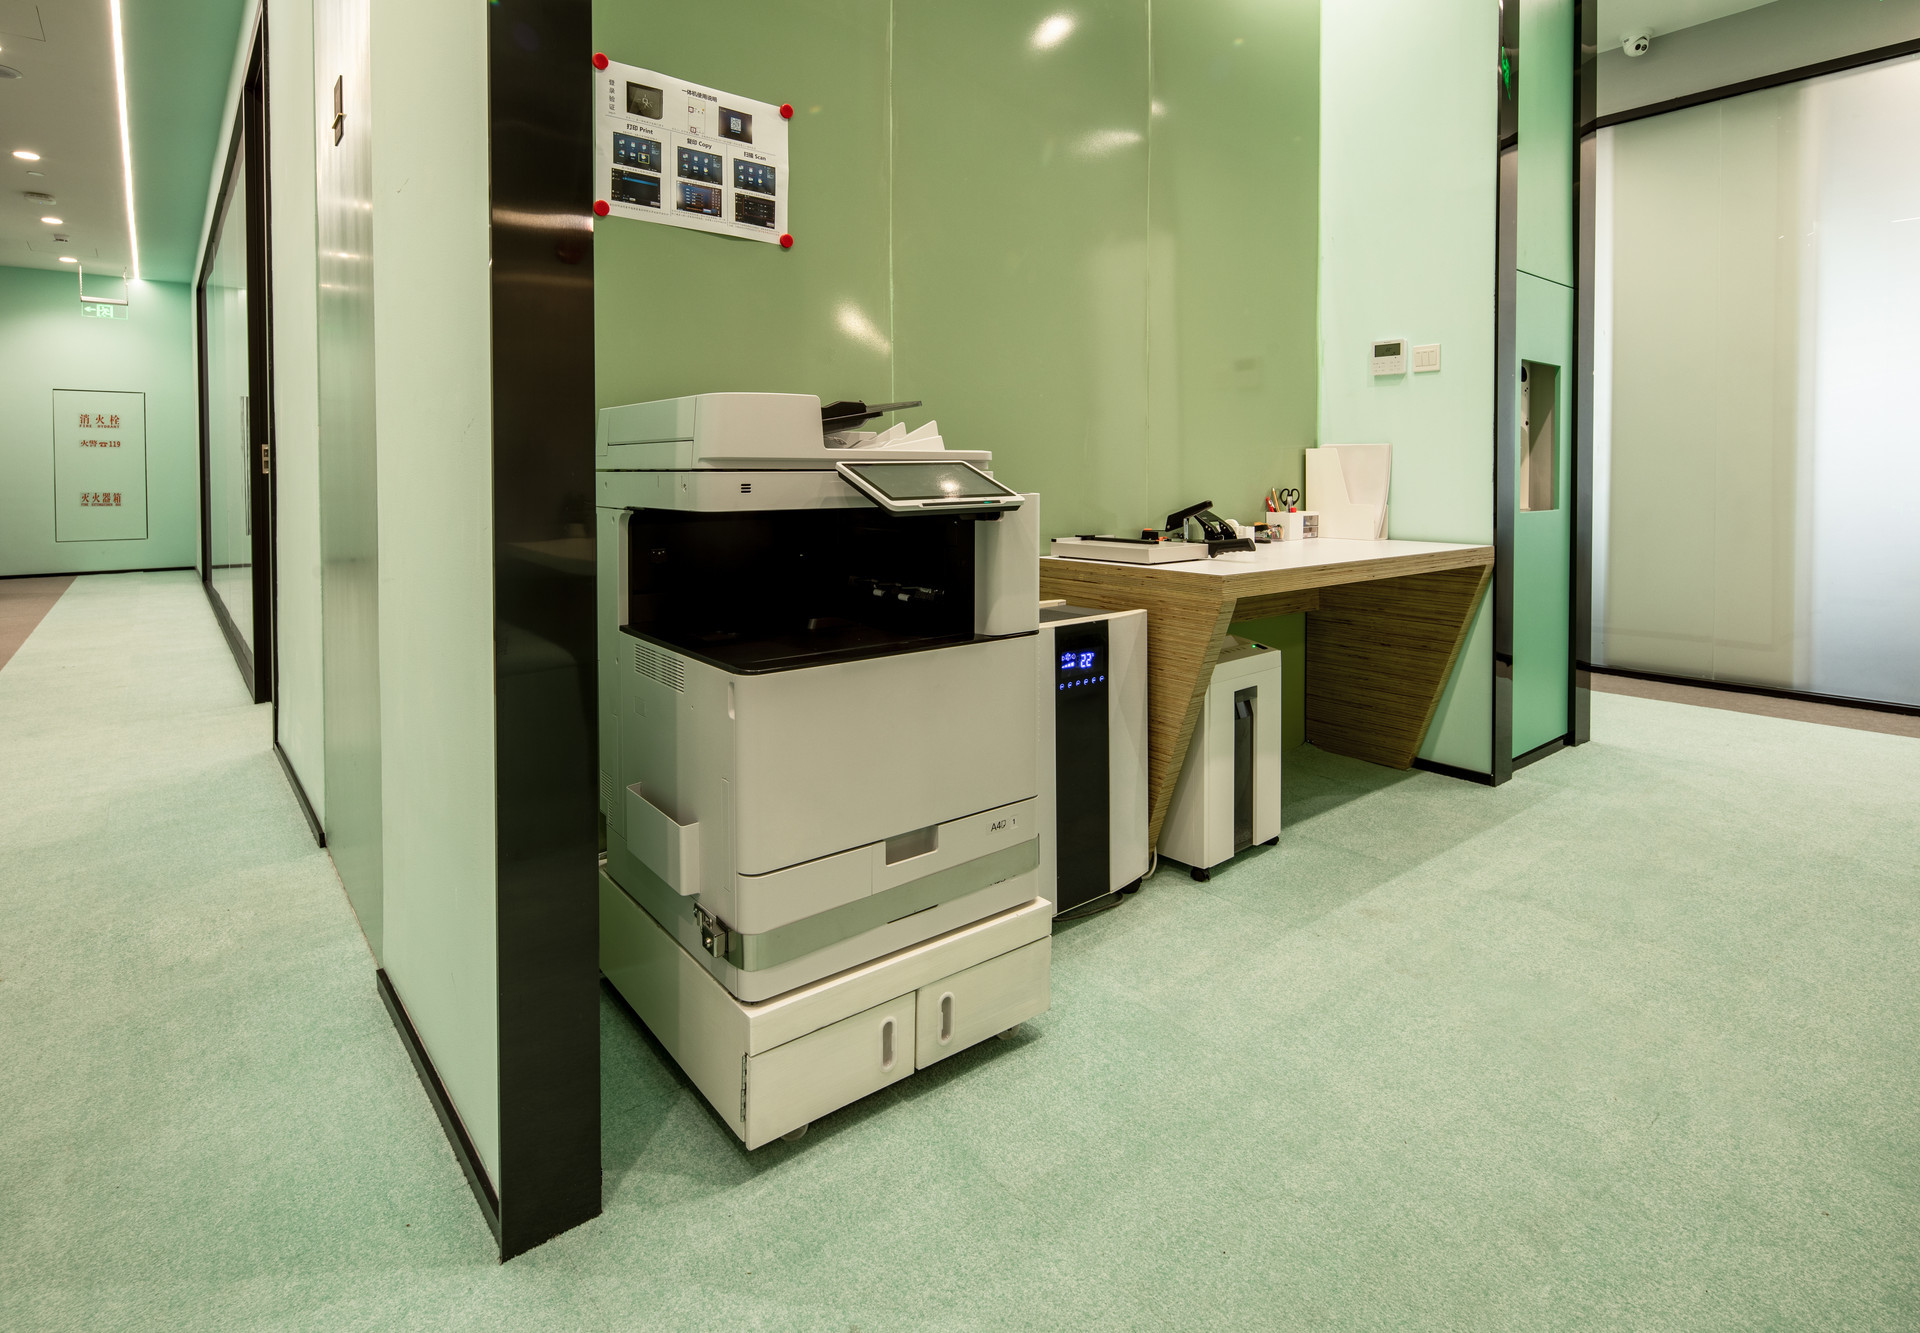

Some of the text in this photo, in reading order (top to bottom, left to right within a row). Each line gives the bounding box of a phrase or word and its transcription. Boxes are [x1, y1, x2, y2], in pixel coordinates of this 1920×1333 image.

[681, 89, 718, 103] 一体机使用说明
[626, 123, 638, 132] 打印
[639, 126, 654, 135] Print
[698, 141, 712, 150] Copy
[743, 151, 767, 161] 扫描 Scan
[80, 413, 120, 424] 消火栓
[80, 440, 98, 448] 火警
[81, 492, 122, 503] 灭火器箱
